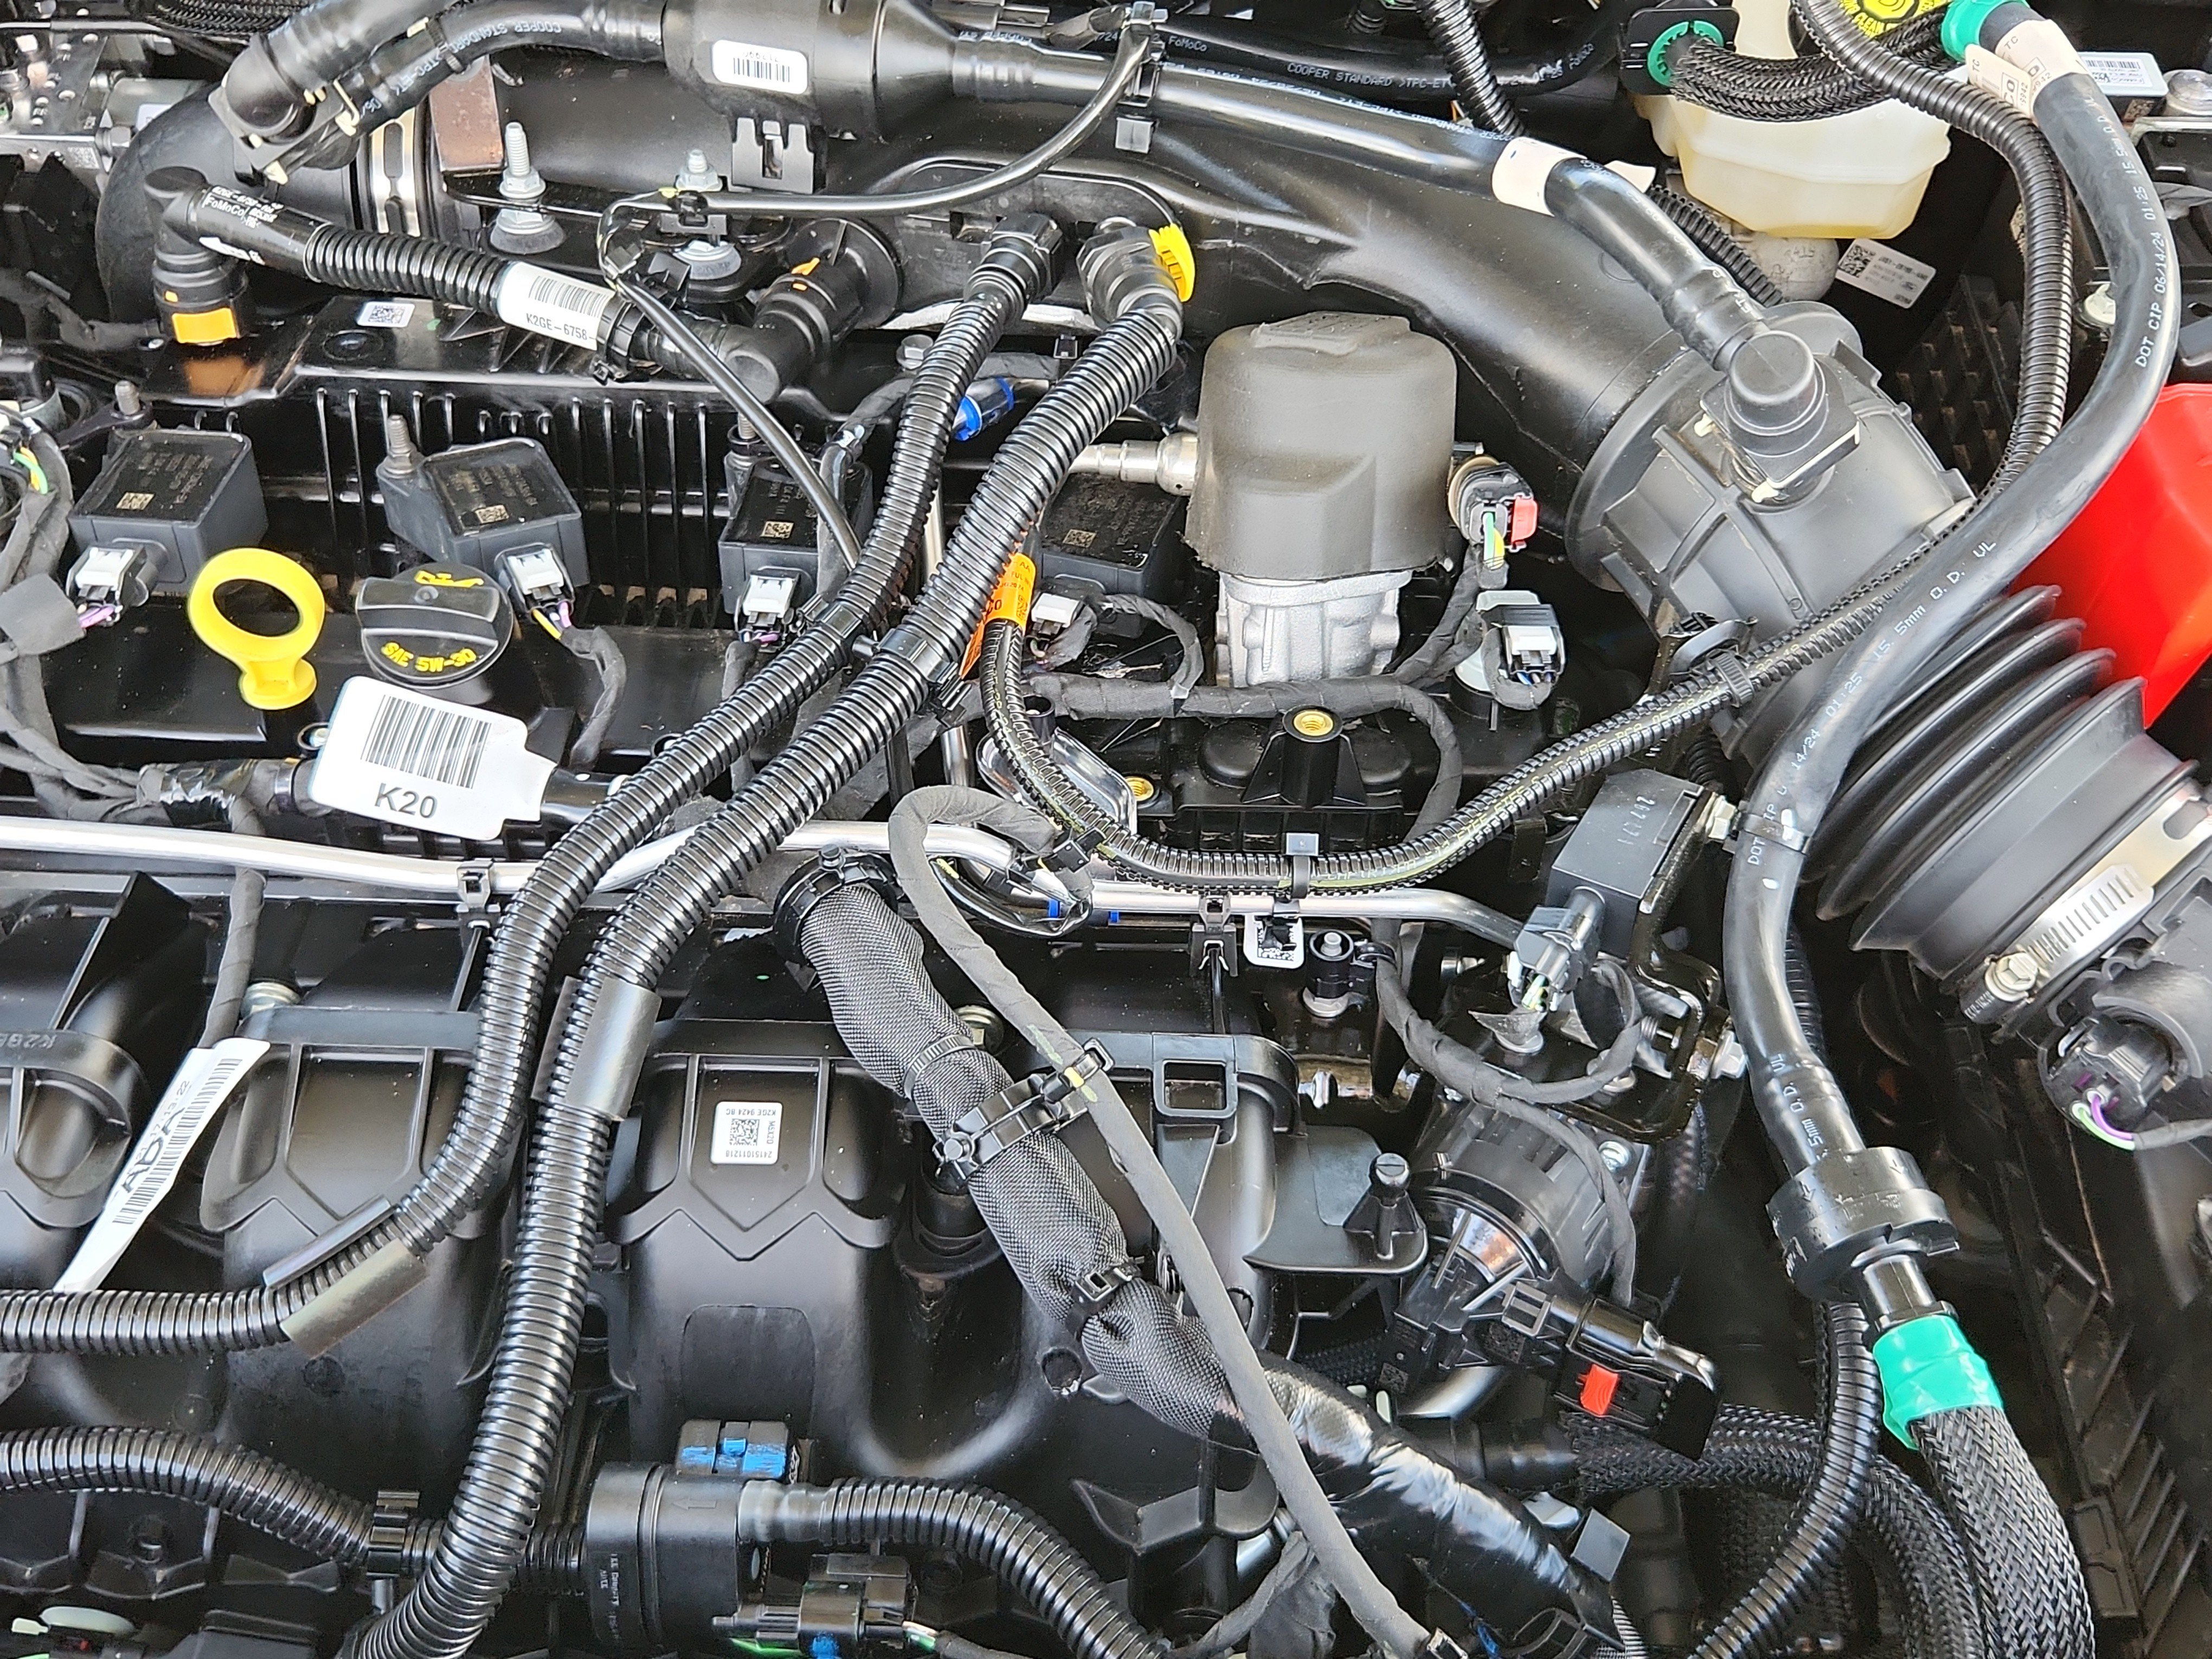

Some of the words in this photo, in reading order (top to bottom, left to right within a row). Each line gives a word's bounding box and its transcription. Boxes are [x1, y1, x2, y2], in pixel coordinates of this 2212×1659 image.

[1168, 35, 1207, 52] FoMoCo
[1287, 62, 1330, 80] COOPER
[1335, 72, 1392, 87] STANDARD
[205, 196, 245, 216] FoMoCo
[2150, 232, 2166, 294] 06/14/24
[2148, 302, 2163, 331] CIP
[2134, 336, 2155, 368] DOT
[381, 642, 414, 667] SAE
[415, 648, 477, 672] 5W-30
[1747, 837, 1765, 866] DOT
[1972, 542, 1996, 557] UL
[374, 782, 438, 819] K20
[1771, 1053, 1786, 1072] UL
